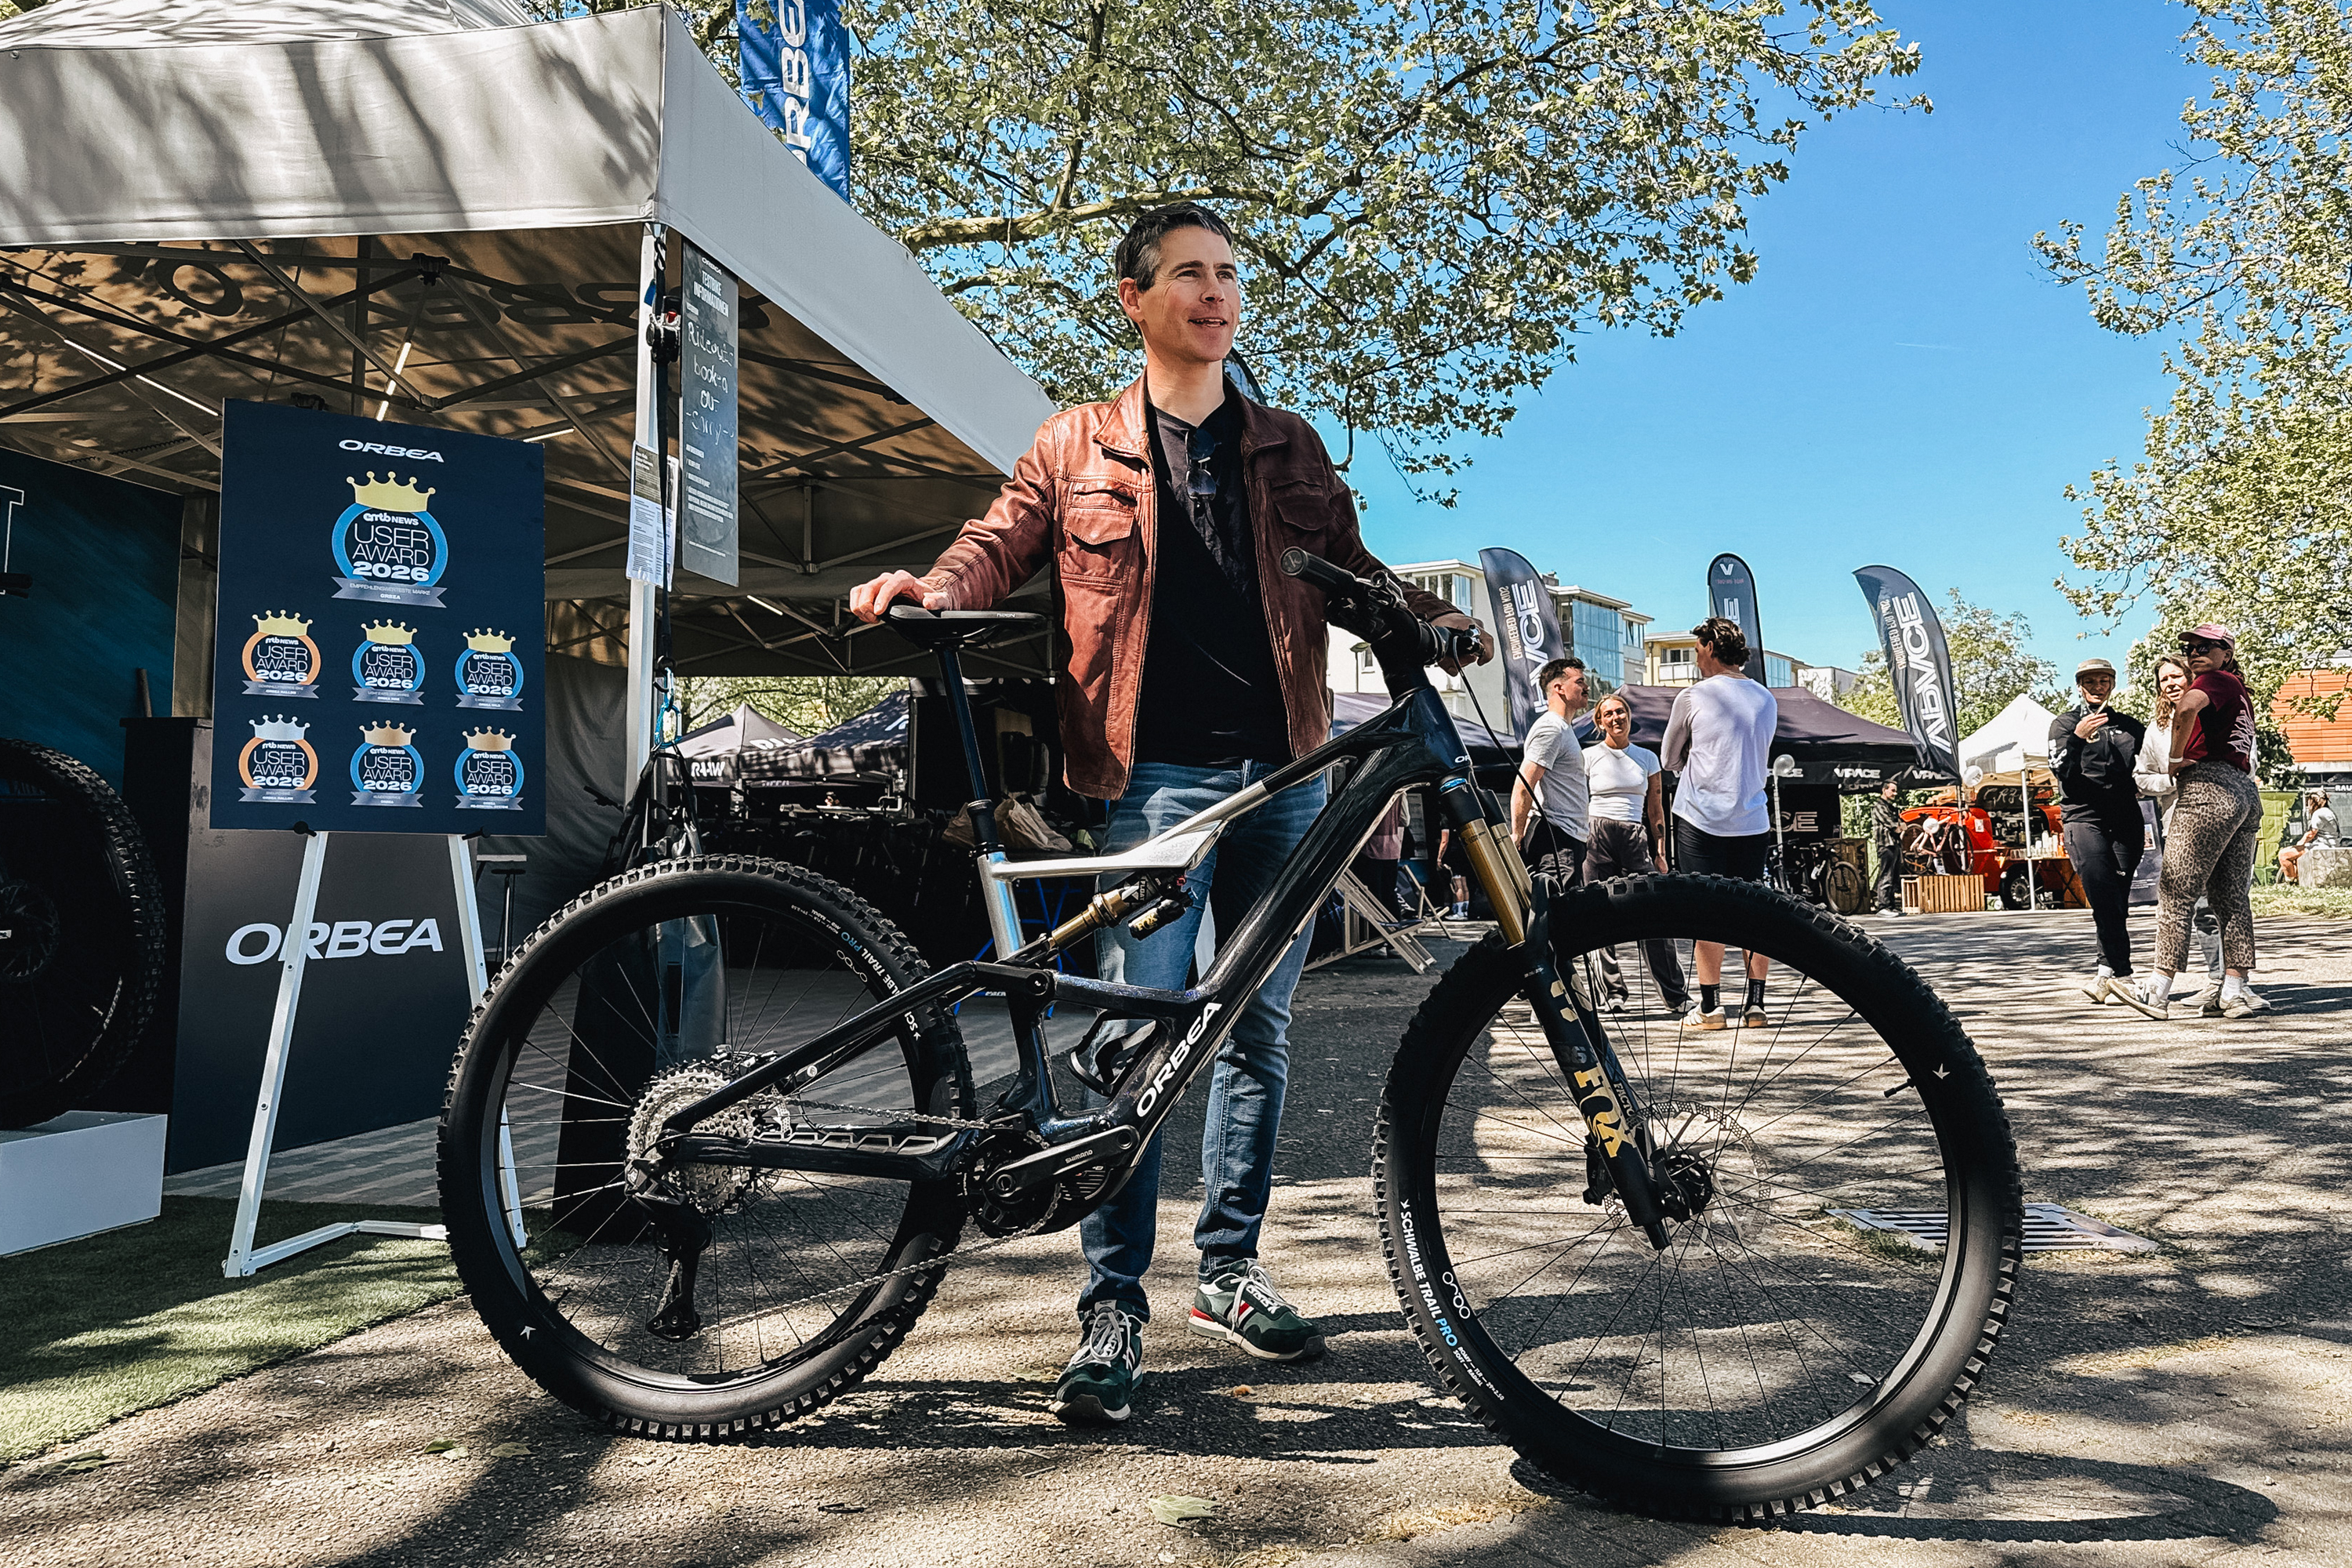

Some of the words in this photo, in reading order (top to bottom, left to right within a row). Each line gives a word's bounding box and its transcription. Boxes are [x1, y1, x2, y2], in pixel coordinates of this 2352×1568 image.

[779, 0, 811, 167] RBE
[339, 439, 445, 463] ORBEA
[354, 523, 429, 550] USER
[352, 543, 429, 566] AWARD
[353, 561, 430, 582] 2026
[257, 644, 307, 661] USER
[256, 658, 308, 672] AWARD
[366, 653, 413, 669] USER
[467, 661, 512, 676] USER
[256, 669, 307, 682] 2026
[365, 666, 413, 679] AWARD
[466, 673, 513, 686] AWARD
[365, 677, 413, 689] 2026
[466, 684, 513, 695] 2026
[254, 750, 305, 765] USER
[364, 756, 412, 770] USER
[252, 764, 305, 777] AWARD
[363, 769, 412, 781] AWARD
[467, 760, 513, 775] USER
[1834, 768, 1881, 778] VPACE
[252, 775, 305, 787] 2026
[363, 780, 412, 791] 2026
[466, 772, 513, 785] AWARD
[466, 783, 514, 795] 2026
[225, 918, 444, 965] ORBEA
[841, 931, 863, 952] PRO
[862, 948, 886, 977] TRAIL
[1137, 1002, 1223, 1118] ORBEA
[1573, 1062, 1637, 1158] FOX
[1065, 1149, 1093, 1163] SHIMANO
[1401, 1211, 1426, 1281] SCHWALBE
[1418, 1281, 1442, 1319] TRAIL
[1436, 1318, 1457, 1347] PRO
[1453, 1349, 1465, 1363] SOFT
[1467, 1369, 1483, 1387] RADIAL
